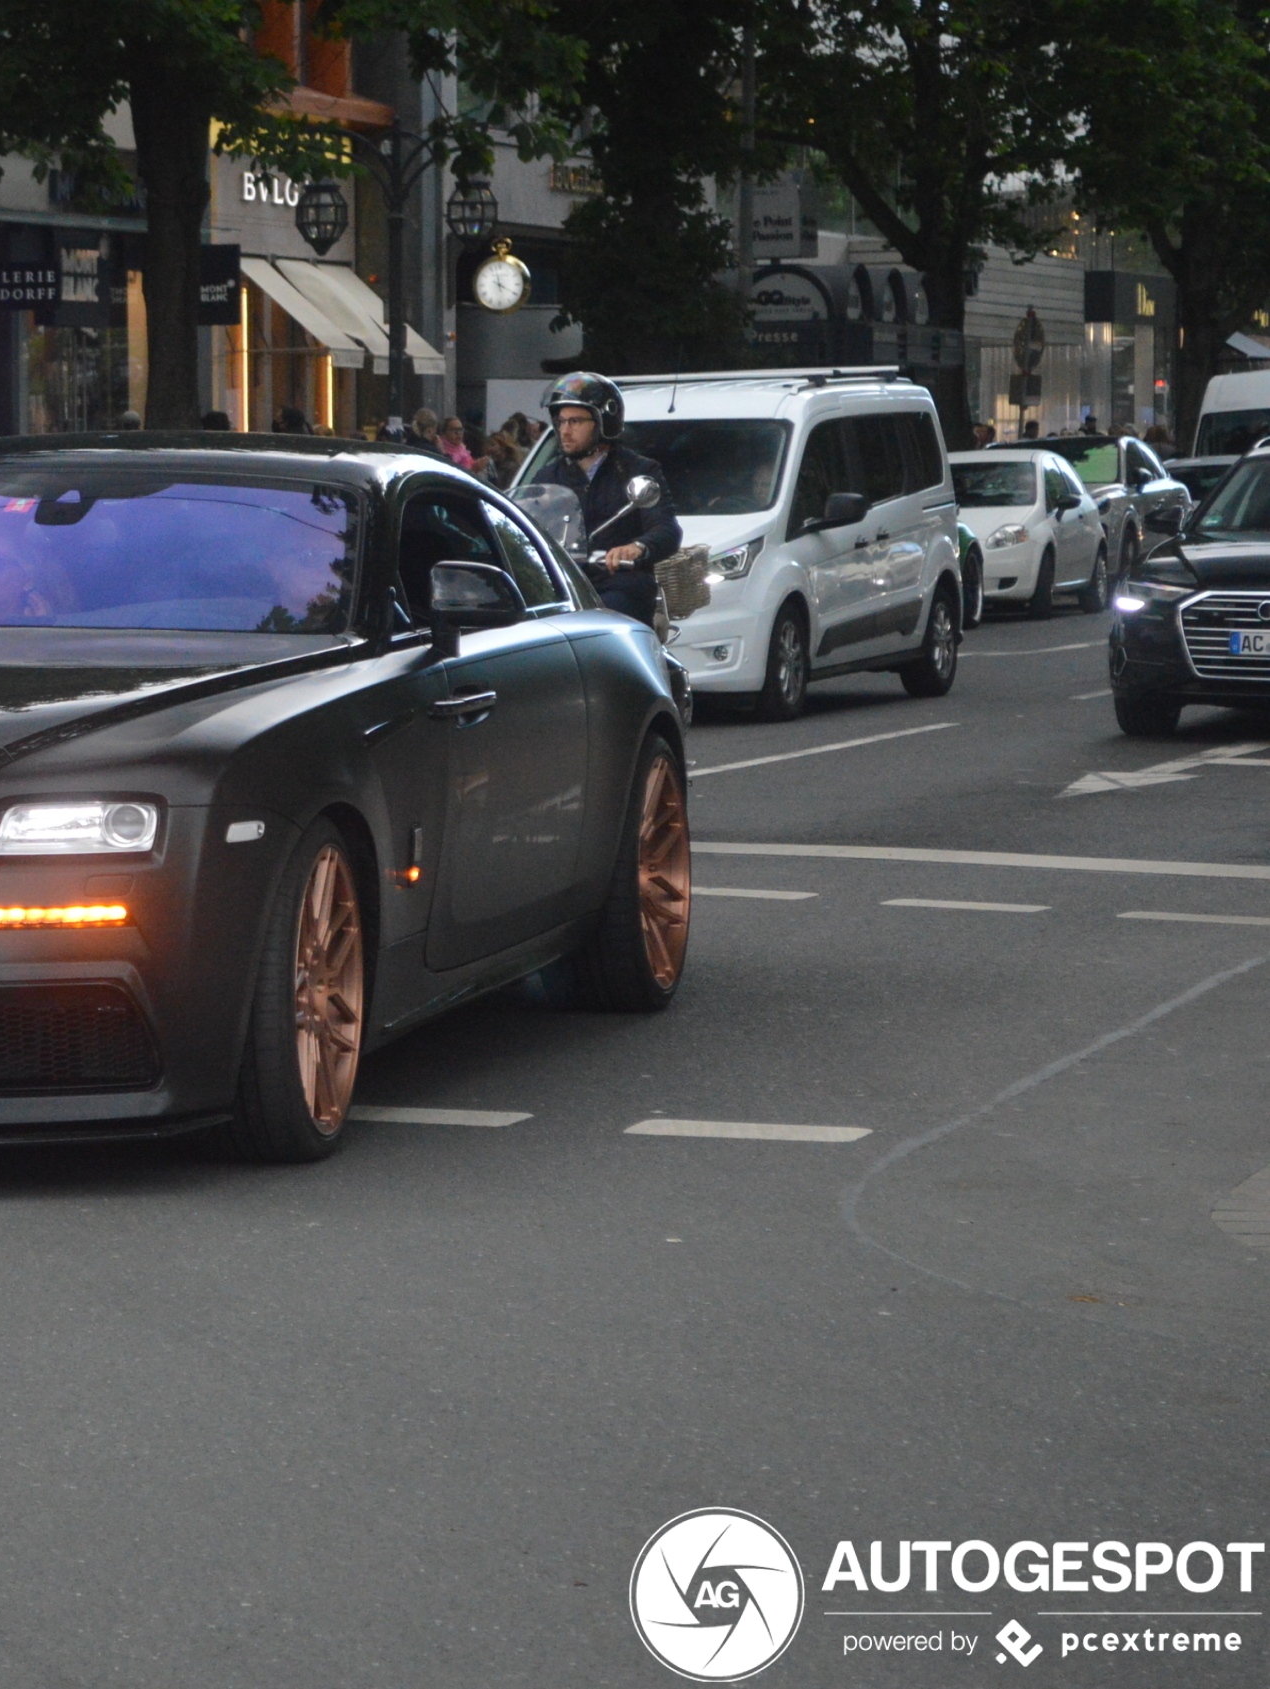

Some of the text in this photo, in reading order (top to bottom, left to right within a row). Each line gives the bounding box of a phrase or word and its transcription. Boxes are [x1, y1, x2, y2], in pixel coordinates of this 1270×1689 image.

[200, 284, 228, 293] MONT
[749, 330, 799, 343] Presse
[1241, 635, 1264, 652] AC
